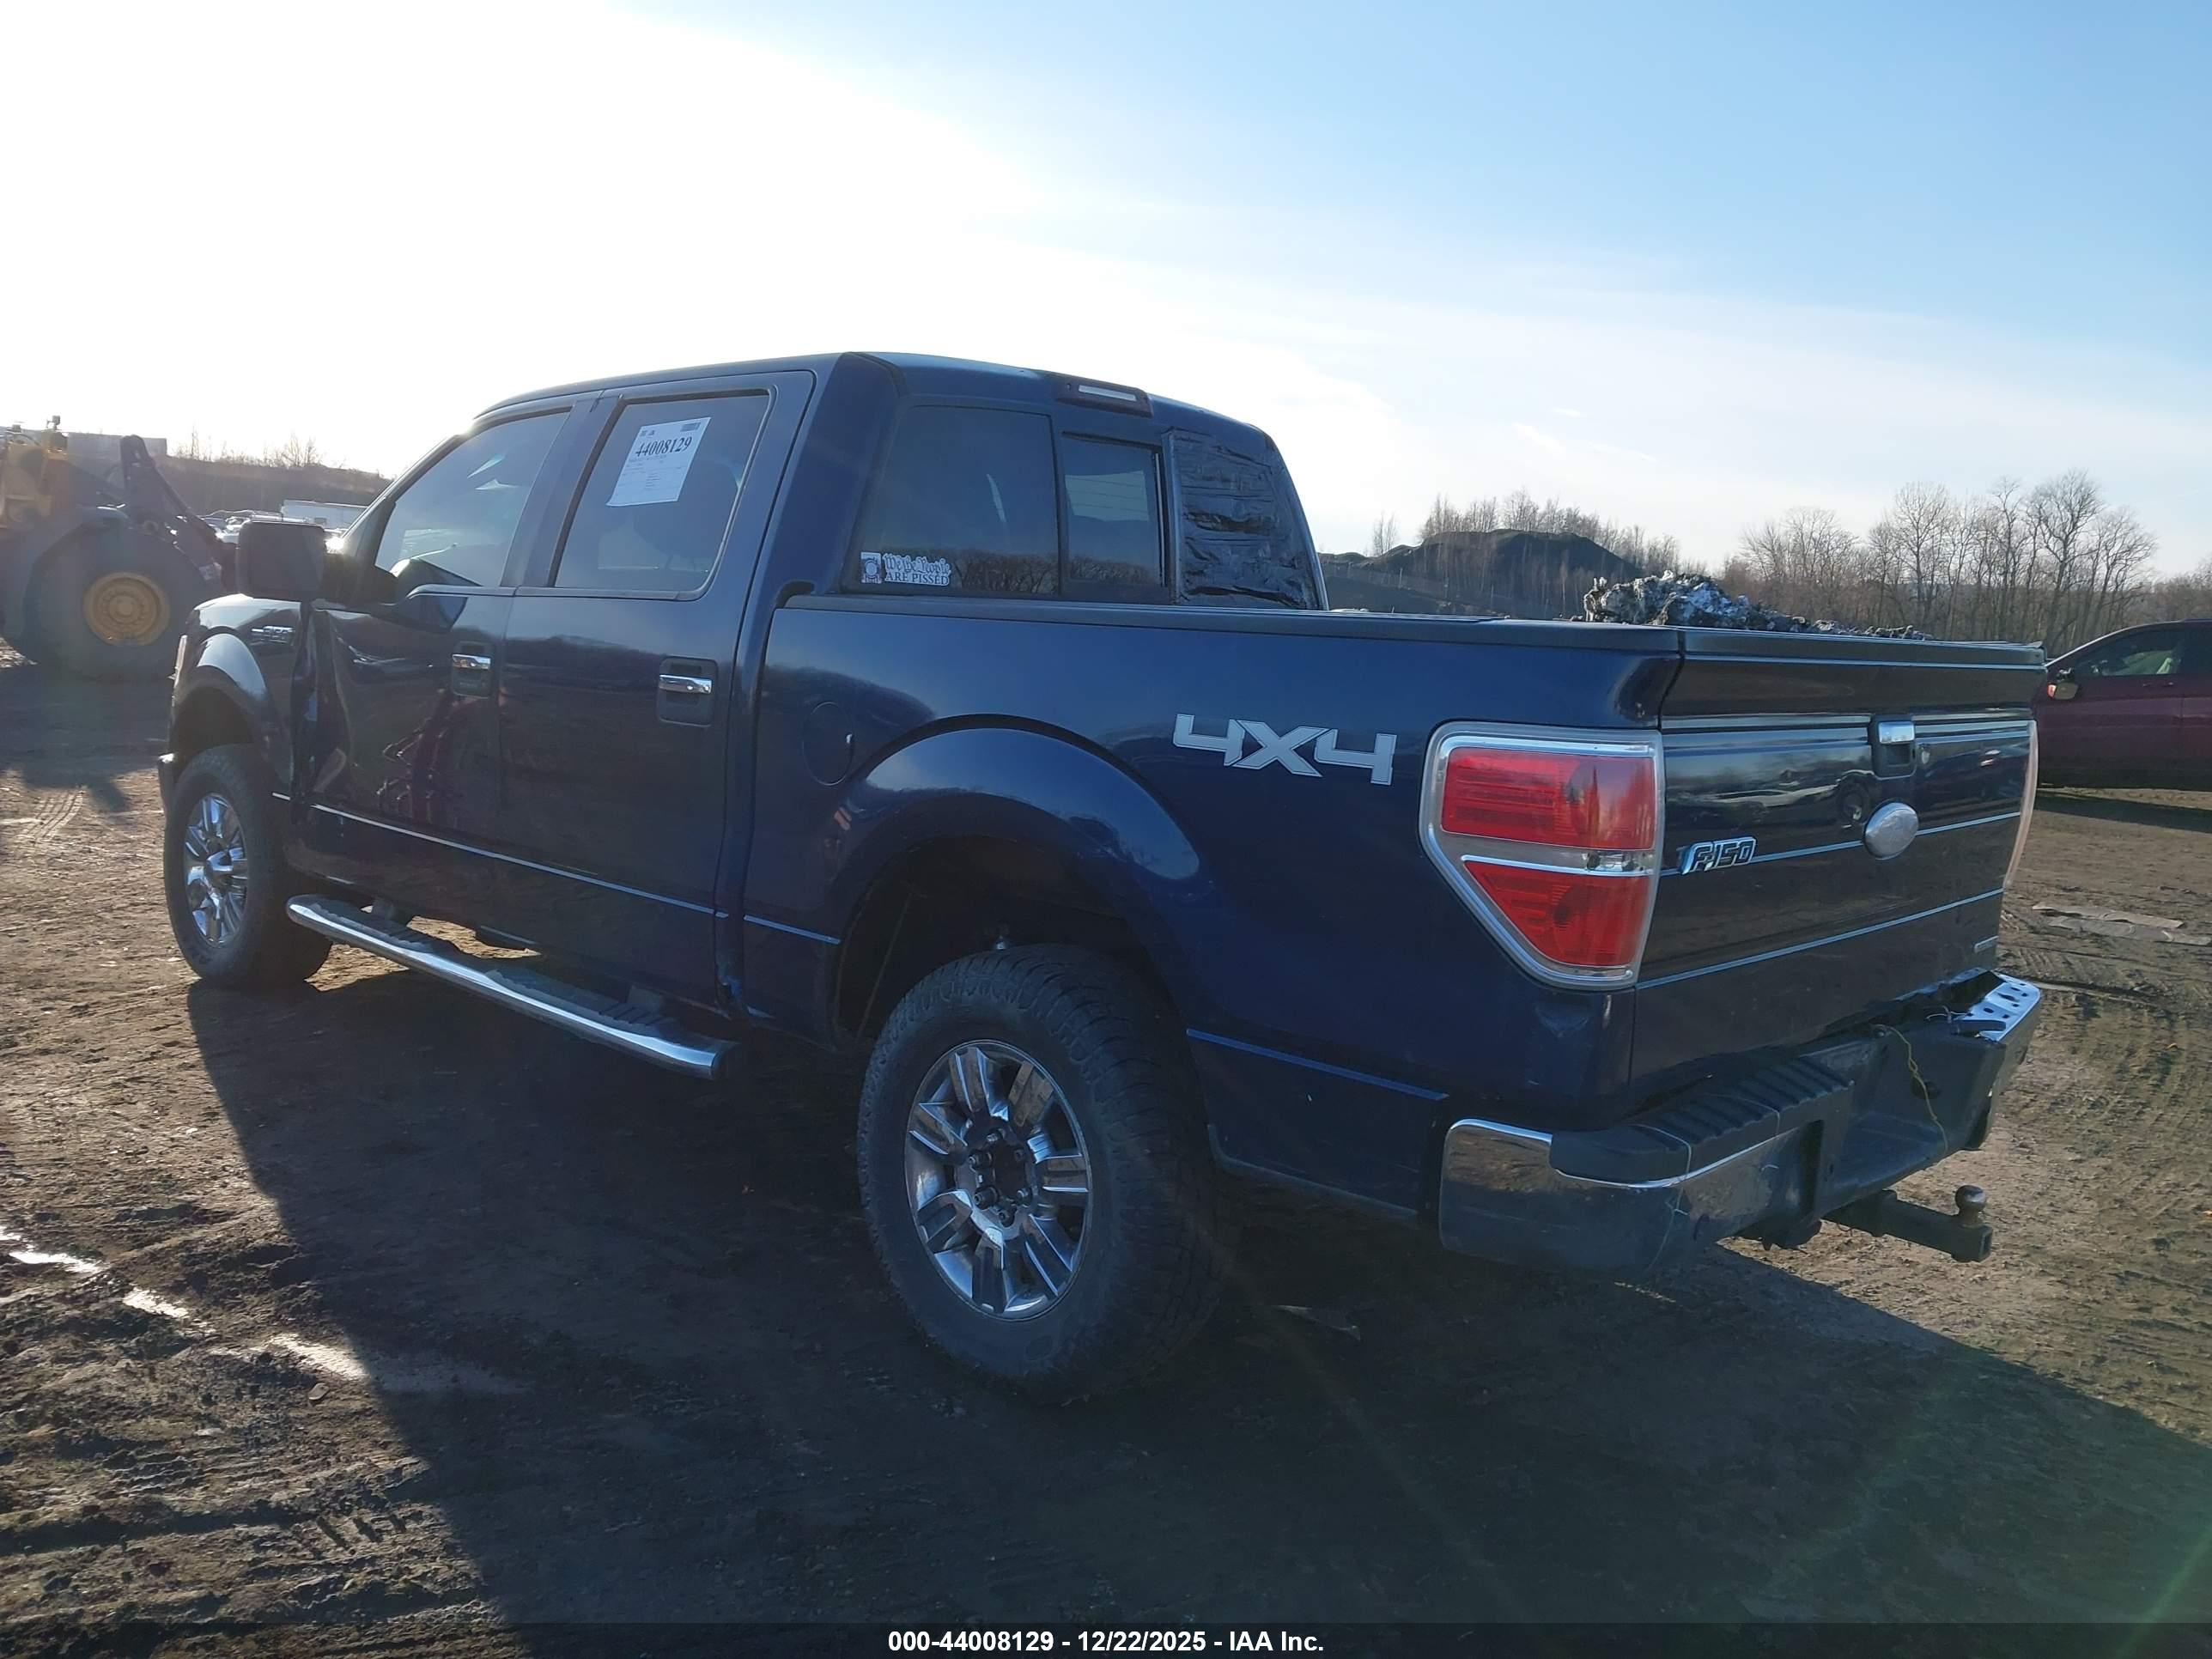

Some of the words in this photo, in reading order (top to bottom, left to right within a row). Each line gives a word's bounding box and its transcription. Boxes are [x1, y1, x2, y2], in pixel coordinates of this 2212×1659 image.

[635, 436, 692, 457] 44008129
[887, 571, 909, 582] ARE
[912, 573, 949, 585] PISSED
